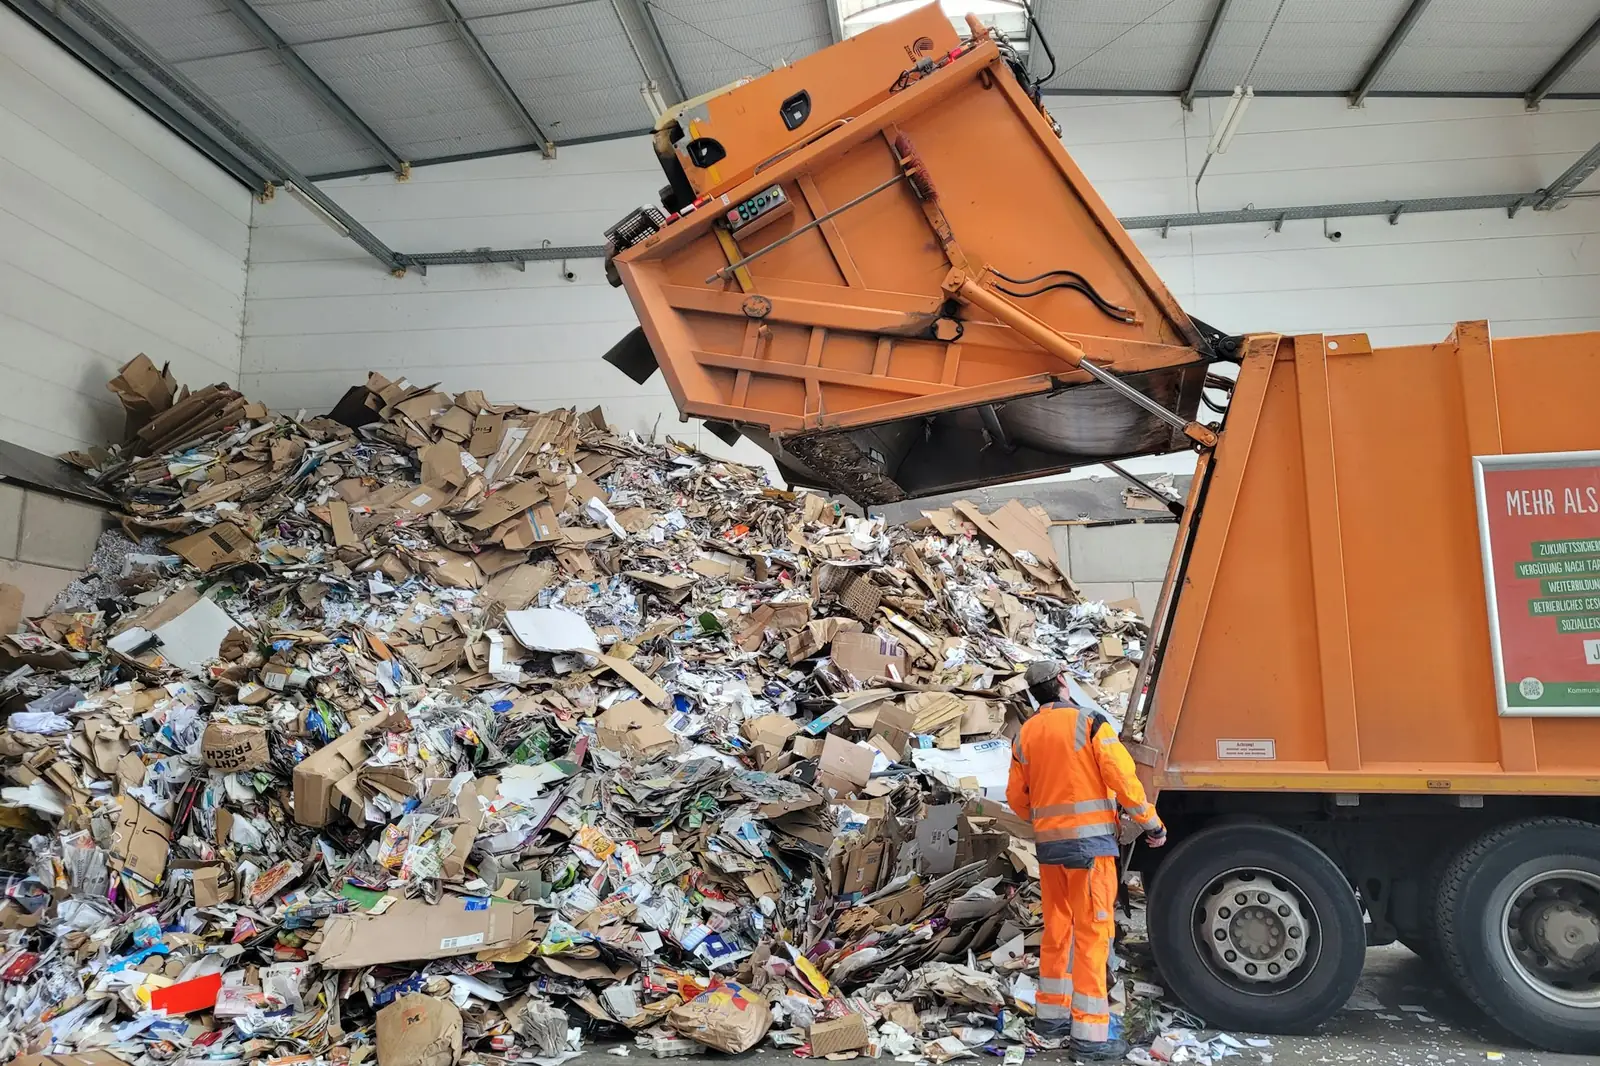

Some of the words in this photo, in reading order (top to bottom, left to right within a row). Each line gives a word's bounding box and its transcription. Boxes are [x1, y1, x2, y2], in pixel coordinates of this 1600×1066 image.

[1506, 488, 1555, 517] MEHR
[1564, 486, 1599, 515] ALS
[1519, 560, 1563, 577] VERGÜTUNG
[1564, 559, 1585, 573] NACH
[1533, 598, 1584, 613] BETRIEBLICHES
[214, 755, 247, 769] ECHT
